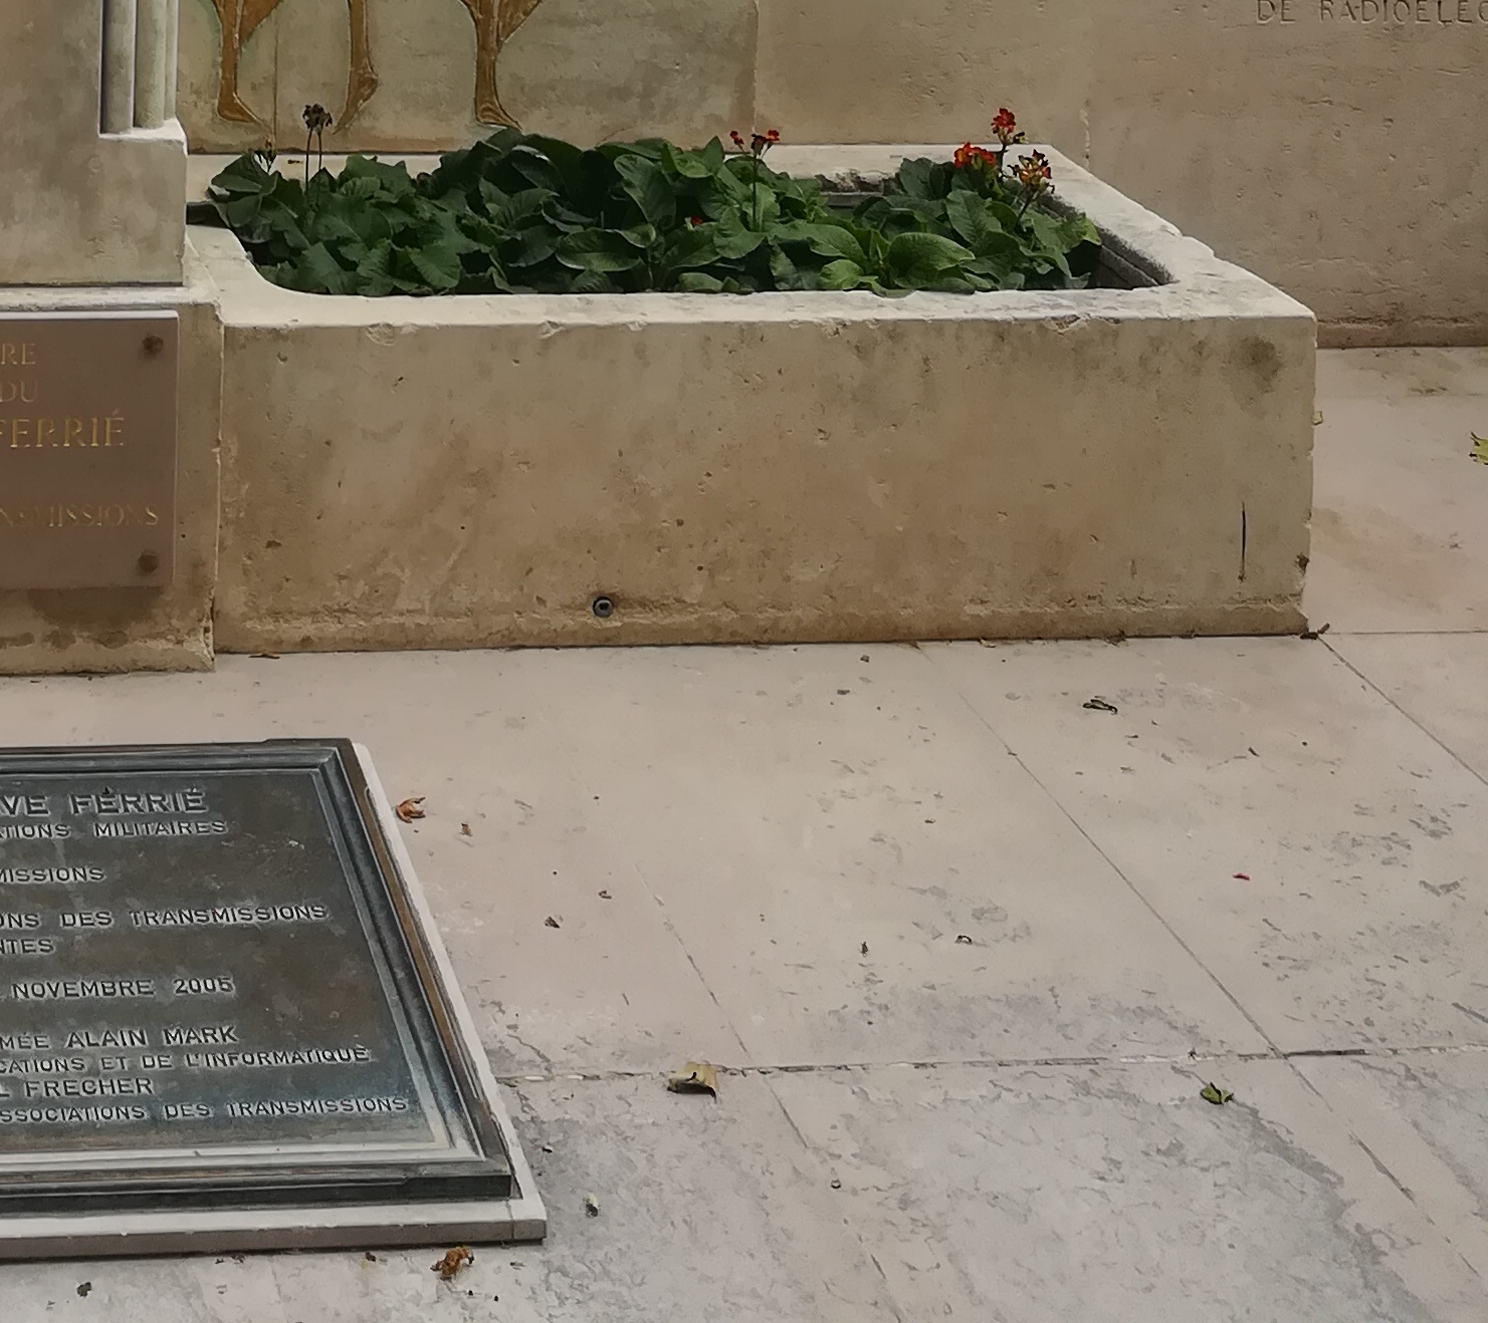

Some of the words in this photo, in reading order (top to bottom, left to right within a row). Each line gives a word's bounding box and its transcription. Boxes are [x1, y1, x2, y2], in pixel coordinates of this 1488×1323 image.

[92, 818, 230, 840] MILITAIRES
[59, 909, 114, 929] DES
[129, 903, 330, 929] TRANSMISSIONS
[11, 977, 156, 1000] NOVEMBRE
[172, 975, 236, 996] 2005
[65, 1027, 149, 1050] ALAIN
[163, 1023, 240, 1046] MARK
[101, 1056, 131, 1071] ET
[142, 1054, 173, 1069] DE
[23, 1077, 155, 1099] FRECHER
[163, 1103, 211, 1120] DES
[226, 1095, 408, 1119] TRANSMISSIONS
